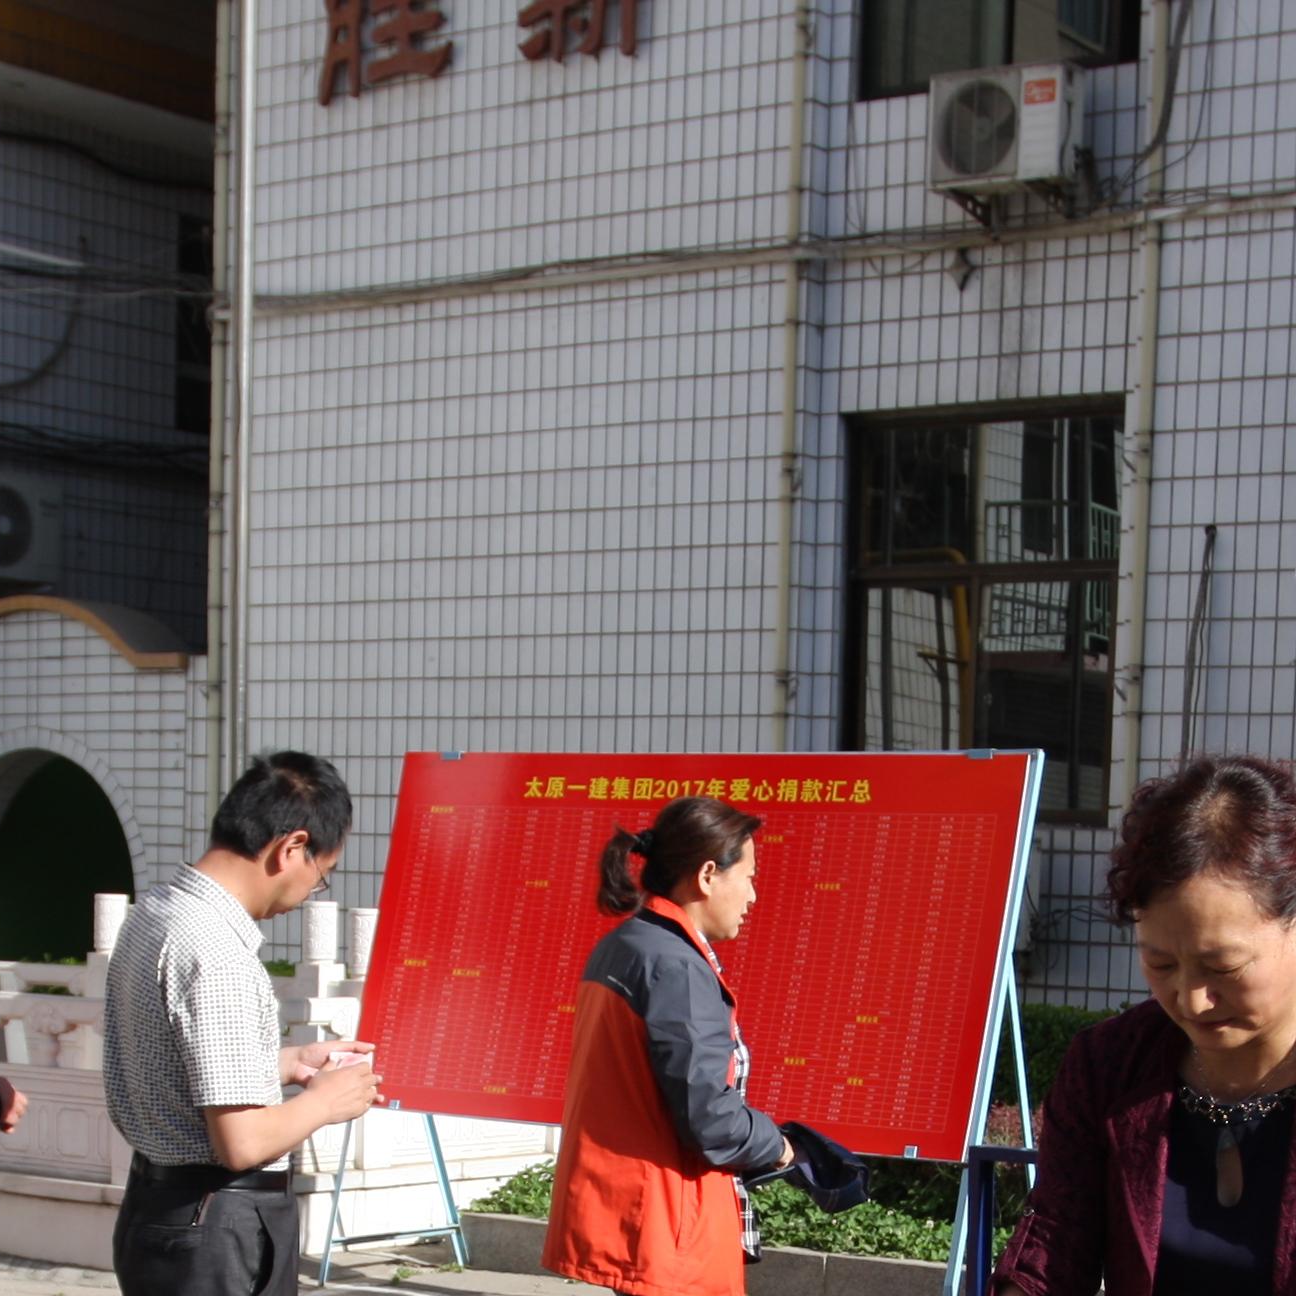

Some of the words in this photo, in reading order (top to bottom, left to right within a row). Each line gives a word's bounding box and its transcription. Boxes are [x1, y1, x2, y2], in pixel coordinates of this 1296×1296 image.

[524, 776, 872, 803] 太原一建集团2017年爱心捐款汇总
